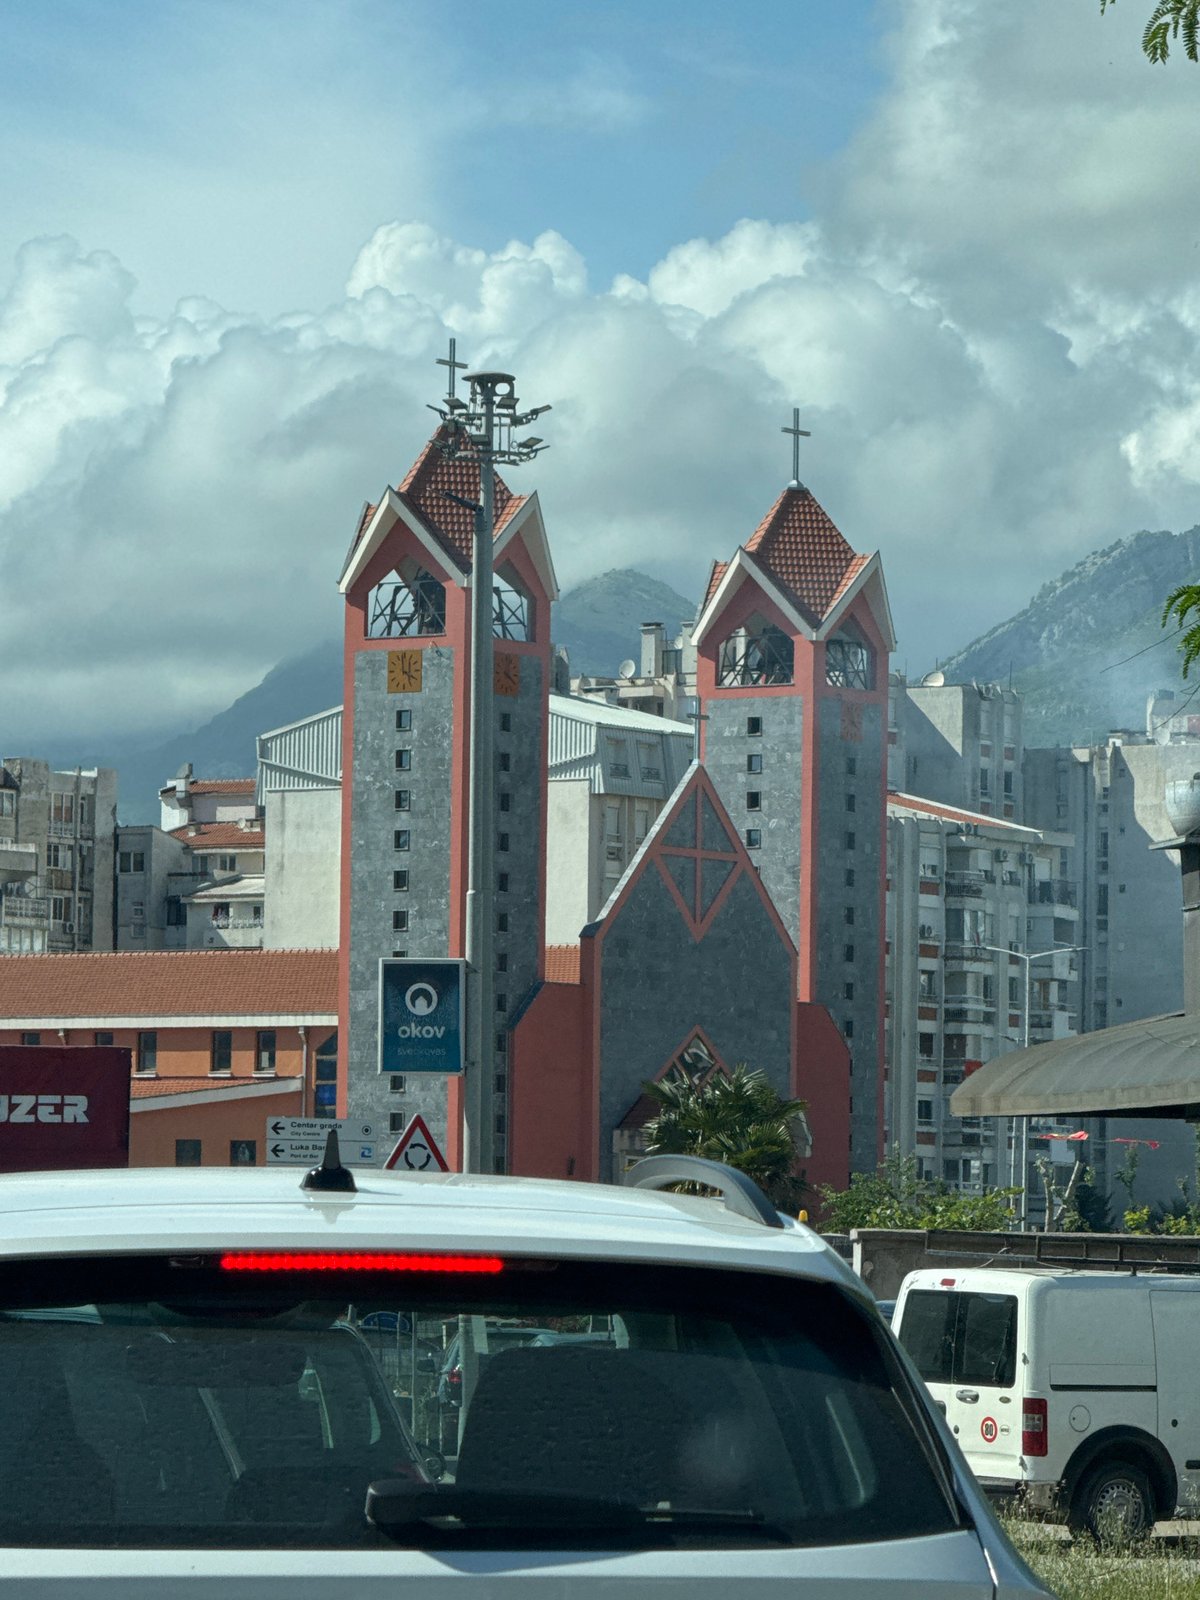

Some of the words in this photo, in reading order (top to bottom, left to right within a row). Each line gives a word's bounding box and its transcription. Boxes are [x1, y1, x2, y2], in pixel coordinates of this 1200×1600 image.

[398, 1022, 446, 1039] okov
[290, 1121, 317, 1129] Centar
[319, 1122, 343, 1130] grada
[290, 1143, 310, 1151] Luka
[984, 1423, 994, 1436] 80
